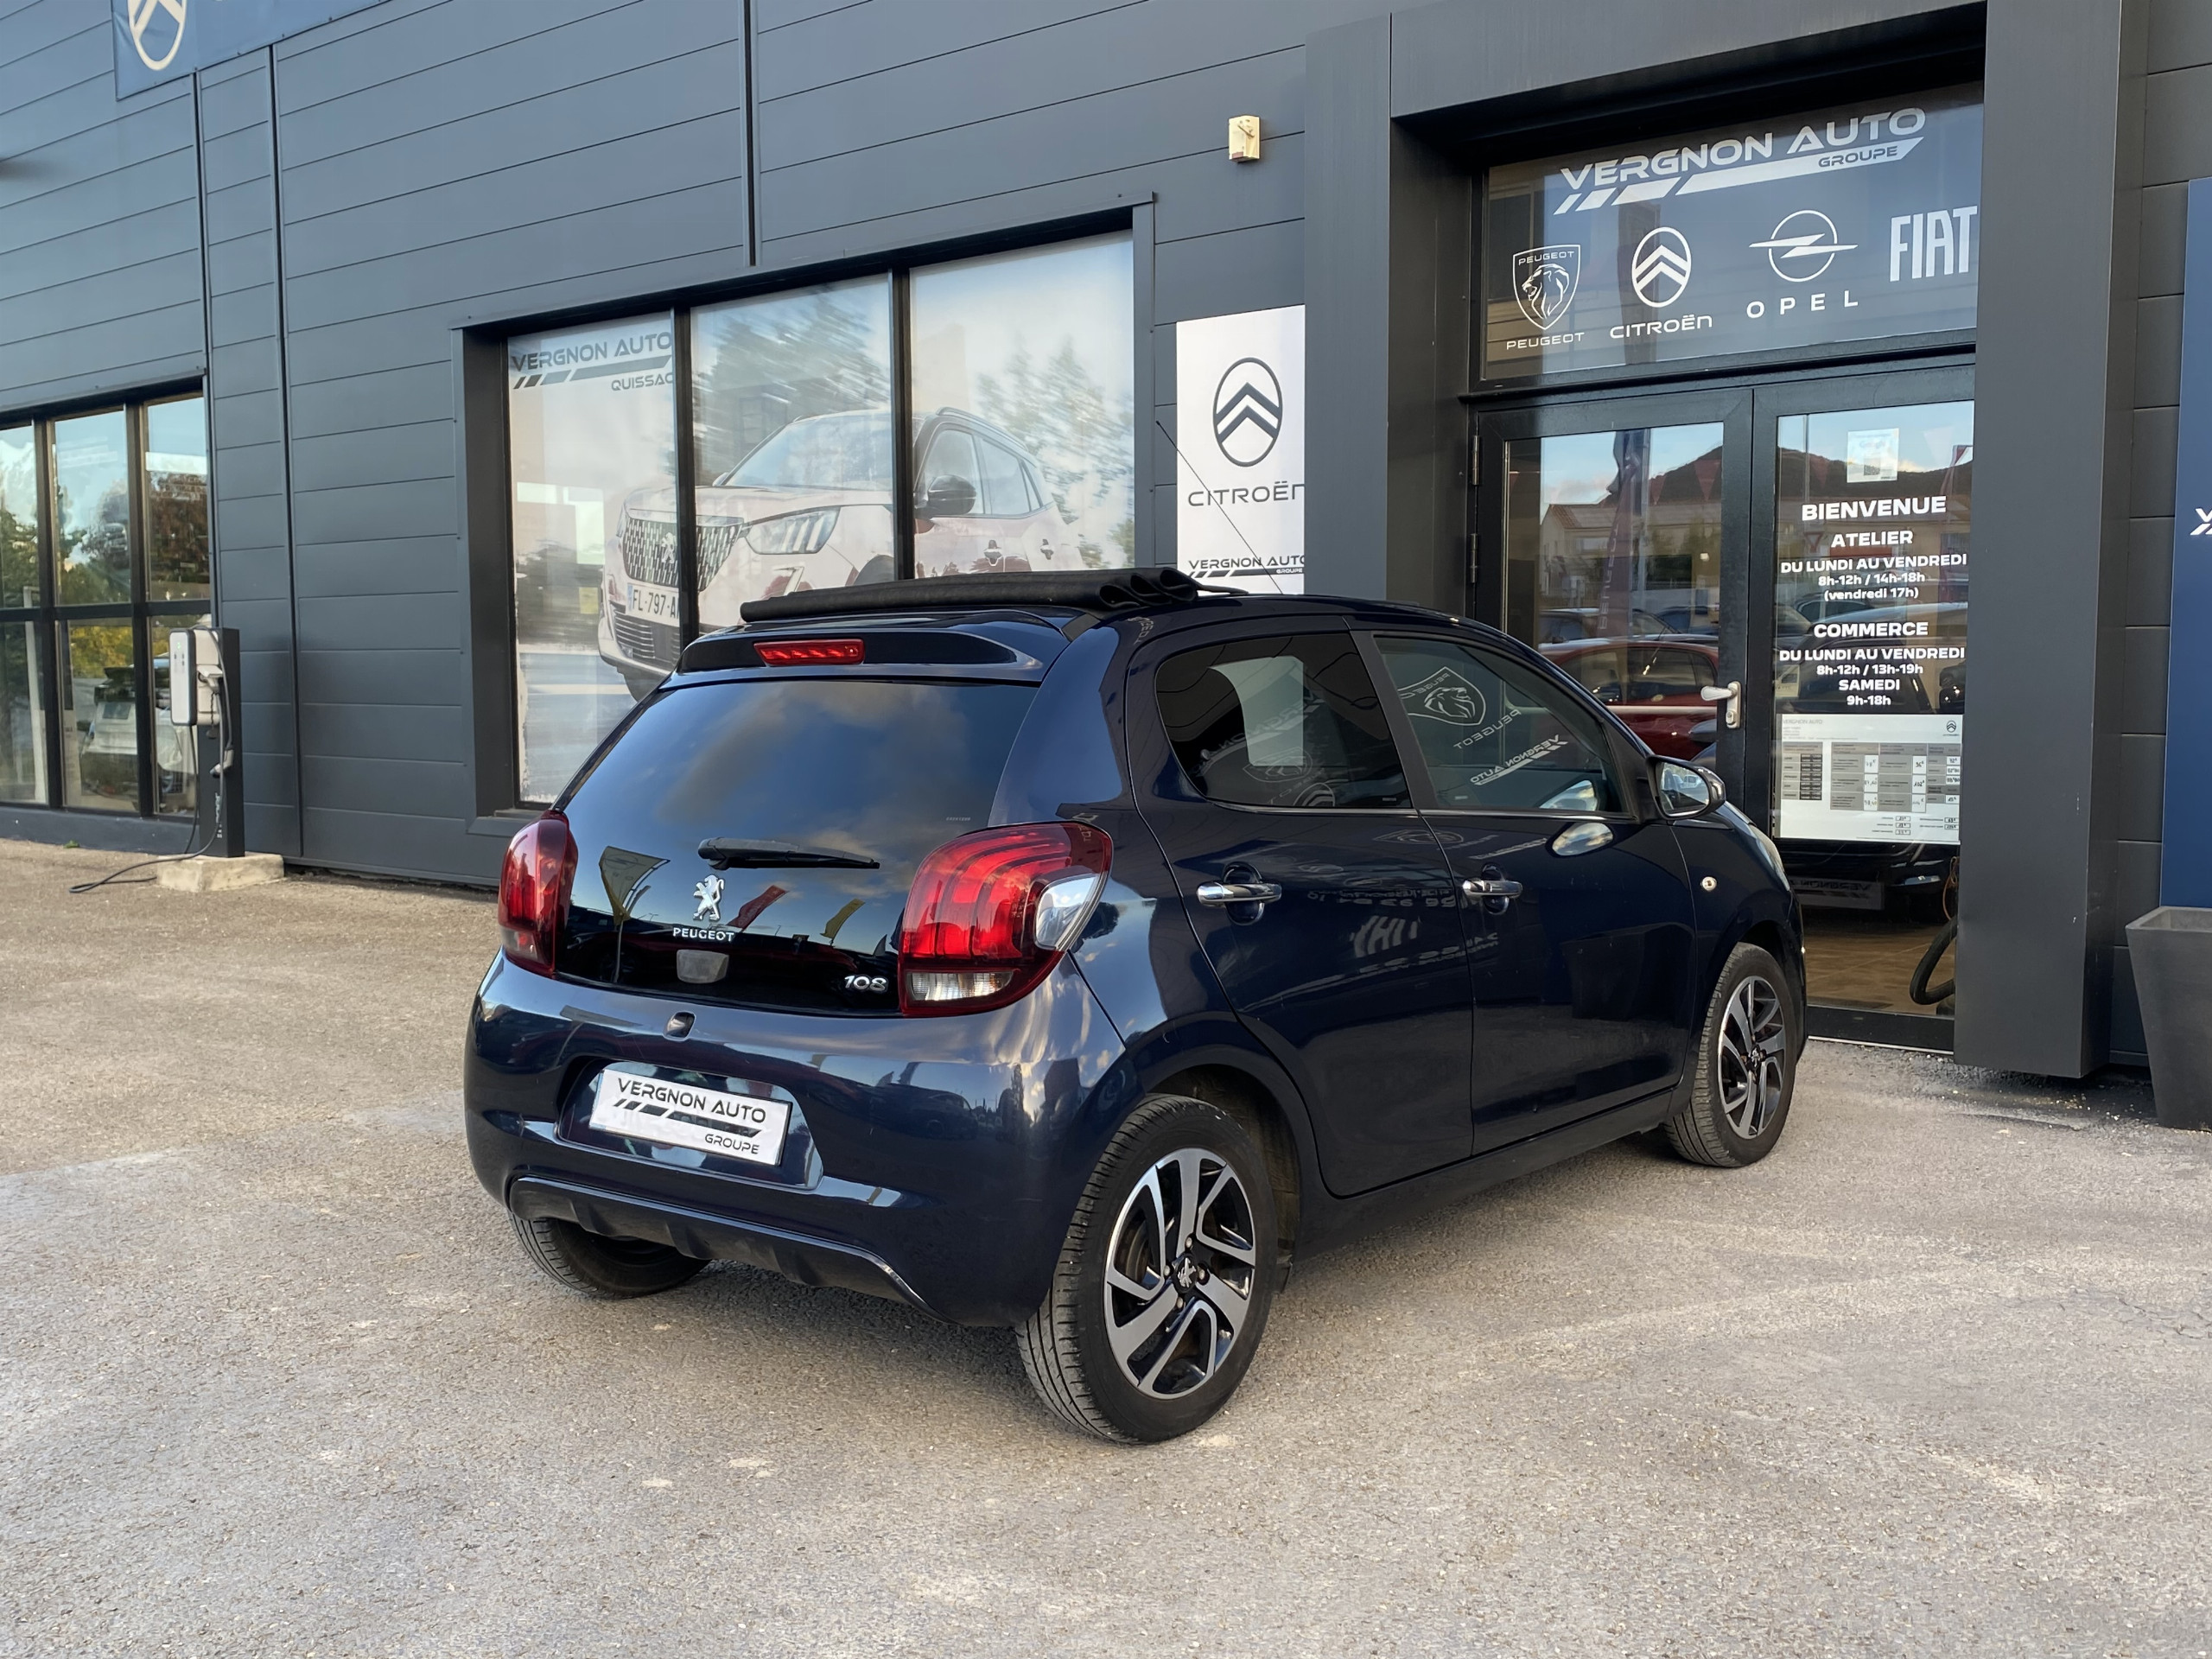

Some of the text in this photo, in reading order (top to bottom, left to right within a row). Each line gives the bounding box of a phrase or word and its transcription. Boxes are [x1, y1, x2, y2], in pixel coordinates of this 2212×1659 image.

[1560, 107, 1926, 190] VERGNON AUTO
[1818, 145, 1898, 168] GROUPE
[1889, 205, 1978, 282] FIAT
[1517, 250, 1575, 266] PEUGEOT
[1746, 289, 1859, 319] OPEL
[1506, 331, 1585, 350] PEUGEOT
[512, 331, 672, 372] VERGNON AUTO
[611, 372, 673, 391] QUISSAC
[1802, 496, 1947, 521] BIENVENUE
[1831, 530, 1913, 548] ATELIER
[1188, 556, 1262, 570] VERGNON
[1781, 553, 1967, 574] DU LUNDI AU VENDREDI
[1818, 574, 1862, 587] 8h-12h
[1875, 571, 1925, 585] 14h-18h
[1823, 587, 1919, 602] (vendredi 17h)
[632, 589, 679, 620] FL-797-A
[1814, 621, 1929, 638] COMMERCE
[1779, 647, 1965, 661] DU LUNDI AU VENDREDI
[1816, 664, 1860, 677] 8h-12h
[1872, 664, 1923, 676] 13h-19h
[1839, 678, 1900, 691] SAMEDI
[1847, 695, 1891, 706] 9h-18h
[672, 927, 734, 942] PEUGEOT
[844, 974, 889, 993] 108
[617, 1077, 766, 1123] VERGNON AUTO
[704, 1134, 760, 1154] GROUPE
